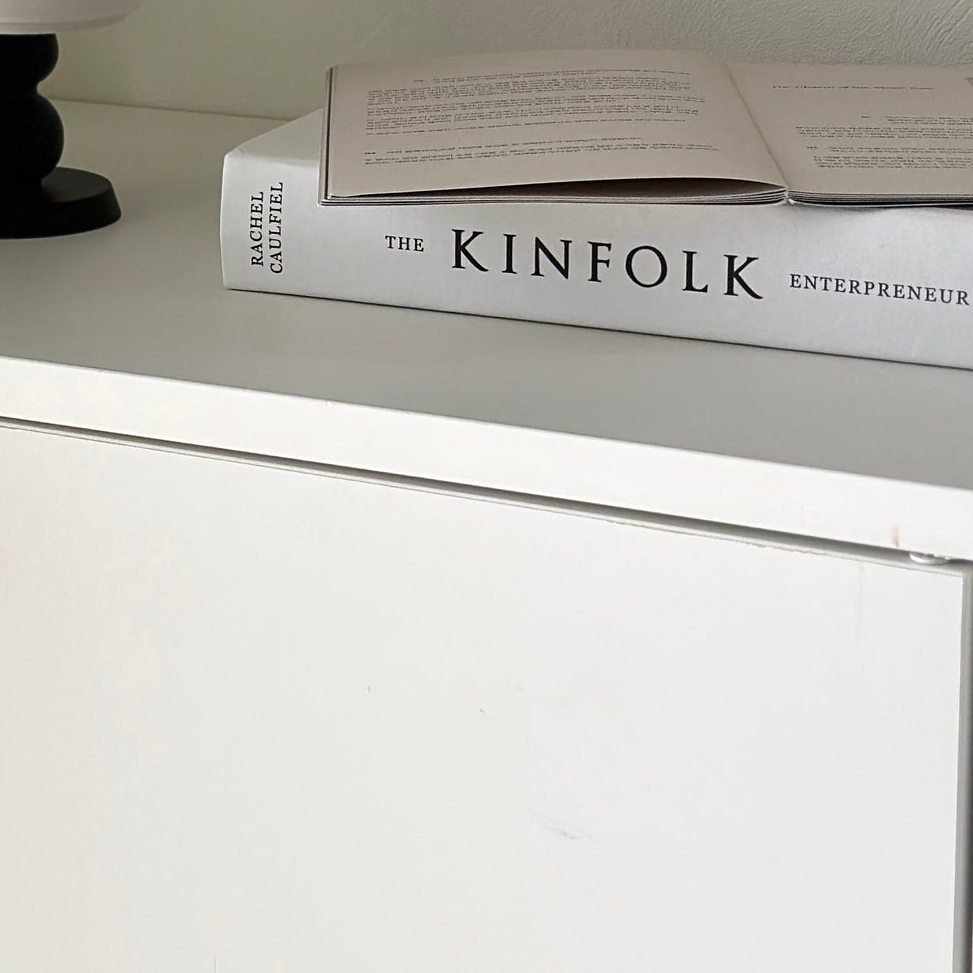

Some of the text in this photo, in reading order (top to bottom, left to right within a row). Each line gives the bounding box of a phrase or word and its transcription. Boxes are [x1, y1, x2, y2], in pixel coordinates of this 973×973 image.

[249, 191, 264, 266] RACHEL
[268, 181, 284, 274] CAULFIEL
[385, 228, 971, 306] THE KINFOLK ENTERPRENEUR
